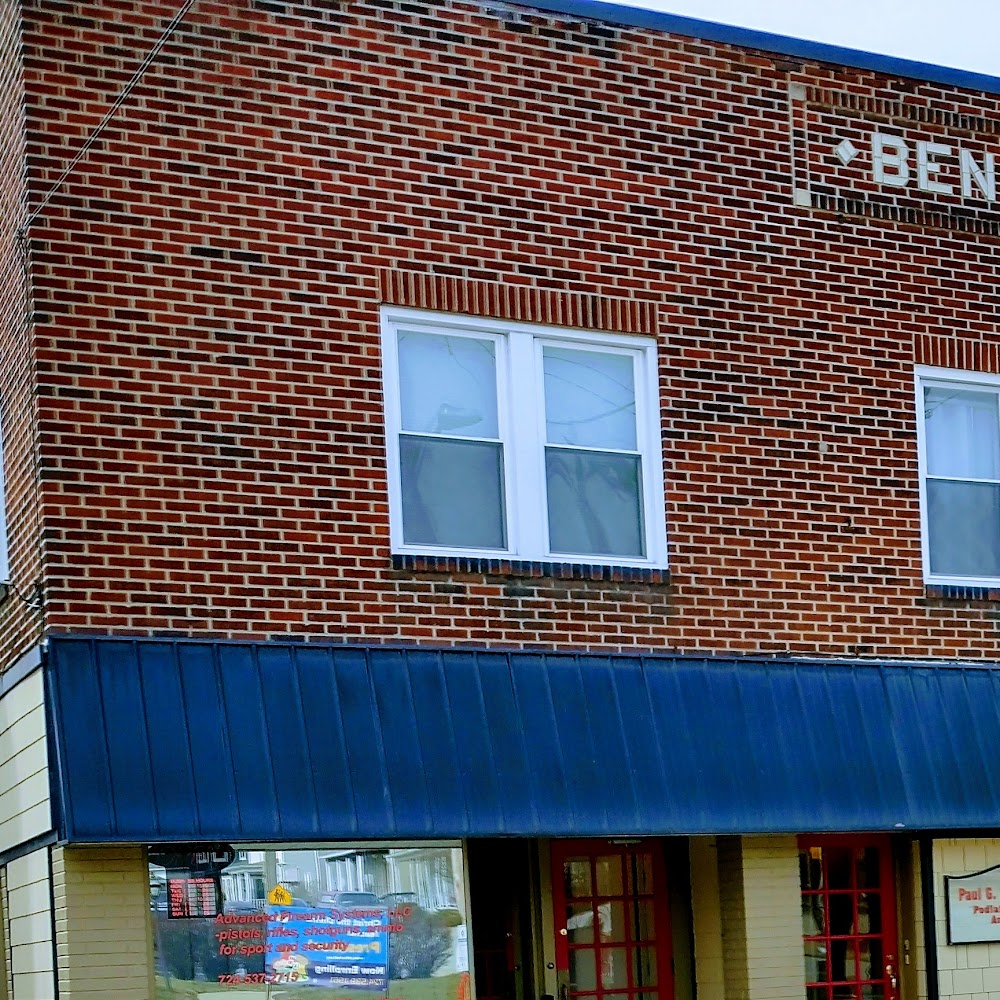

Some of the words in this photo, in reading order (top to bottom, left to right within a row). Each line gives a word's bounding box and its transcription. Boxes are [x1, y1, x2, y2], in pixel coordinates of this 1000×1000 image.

[958, 887, 981, 901] Paul
[215, 912, 277, 925] Advanced
[281, 911, 326, 920] Firearm
[387, 906, 411, 917] LLC
[366, 924, 404, 933] ammo
[219, 944, 237, 955] for
[240, 943, 272, 956] sport
[276, 942, 298, 952] and
[302, 940, 349, 952] security
